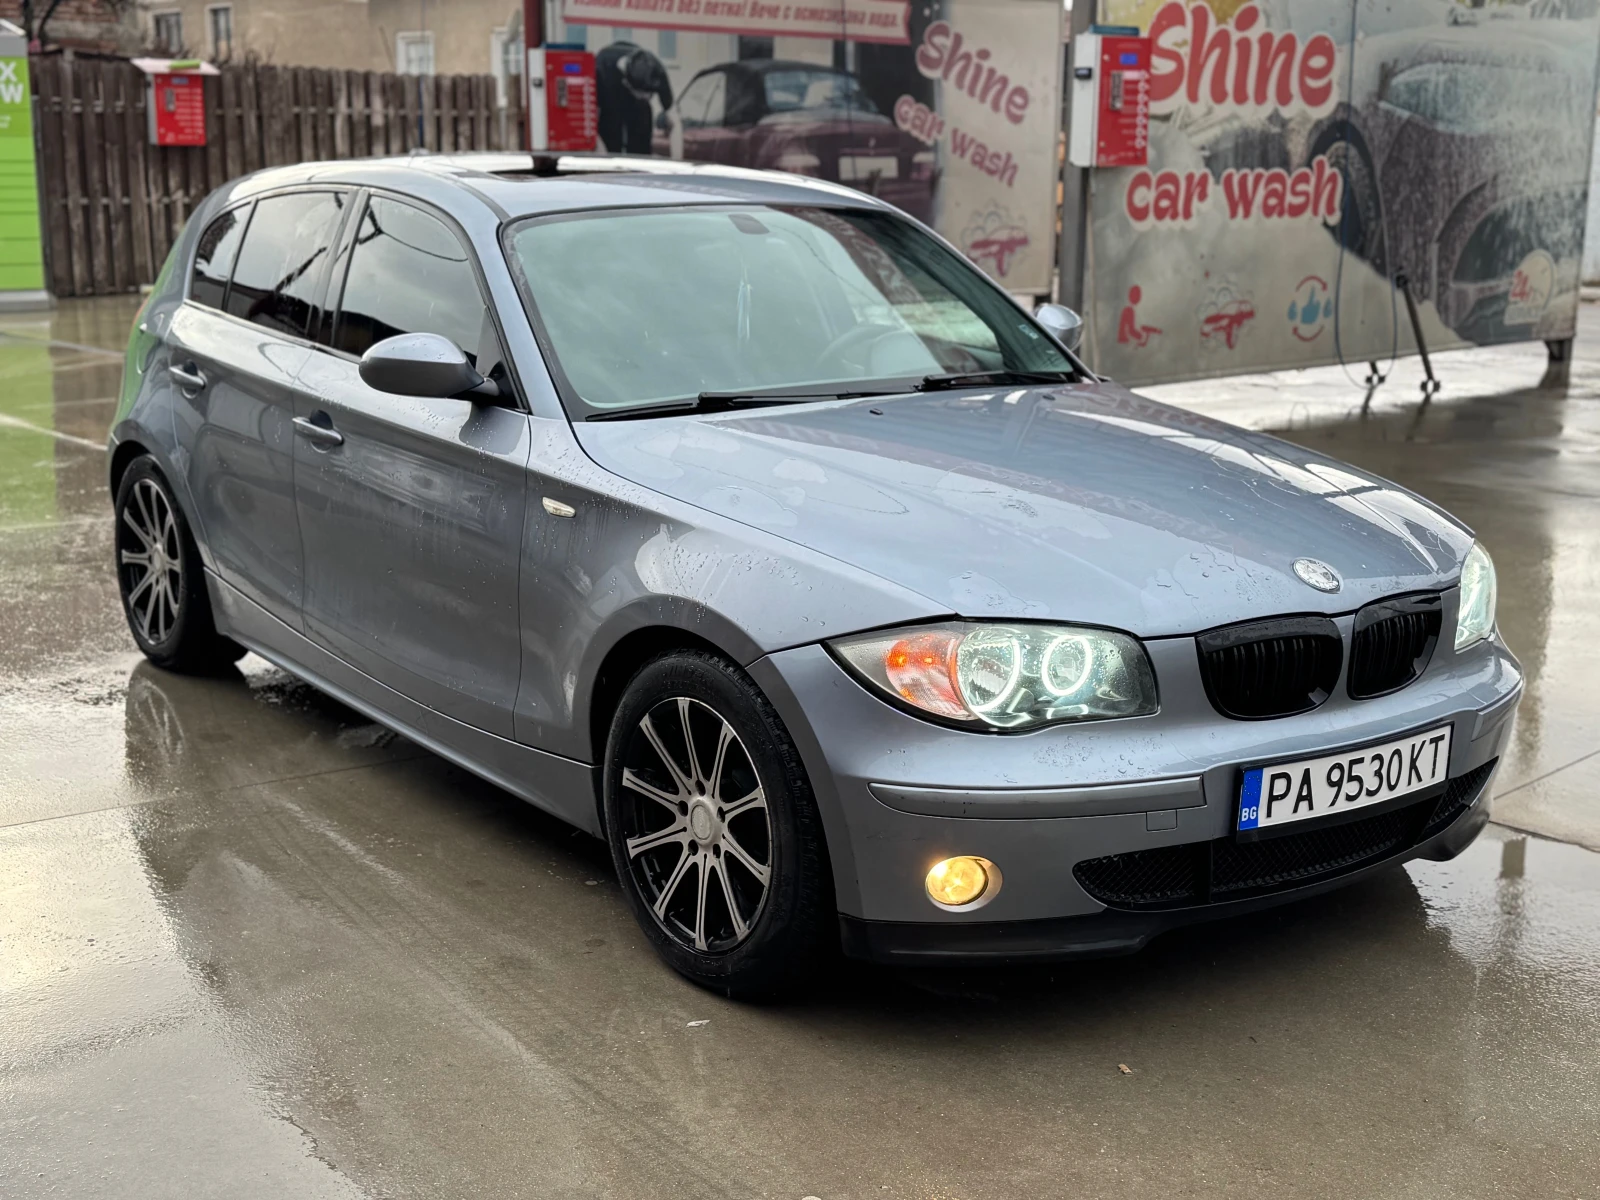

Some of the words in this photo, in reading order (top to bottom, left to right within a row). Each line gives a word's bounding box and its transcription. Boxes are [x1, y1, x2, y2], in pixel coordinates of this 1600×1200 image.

[748, 2, 780, 19] Вече
[916, 22, 1030, 126] Shine
[1149, 1, 1336, 108] Shine
[895, 95, 946, 141] car
[951, 126, 1019, 188] wash
[1126, 171, 1210, 222] car
[1222, 157, 1339, 221] wash
[1241, 806, 1258, 823] BG
[1266, 767, 1315, 819] PA
[1326, 747, 1403, 808] 9530
[1406, 733, 1446, 787] KT
